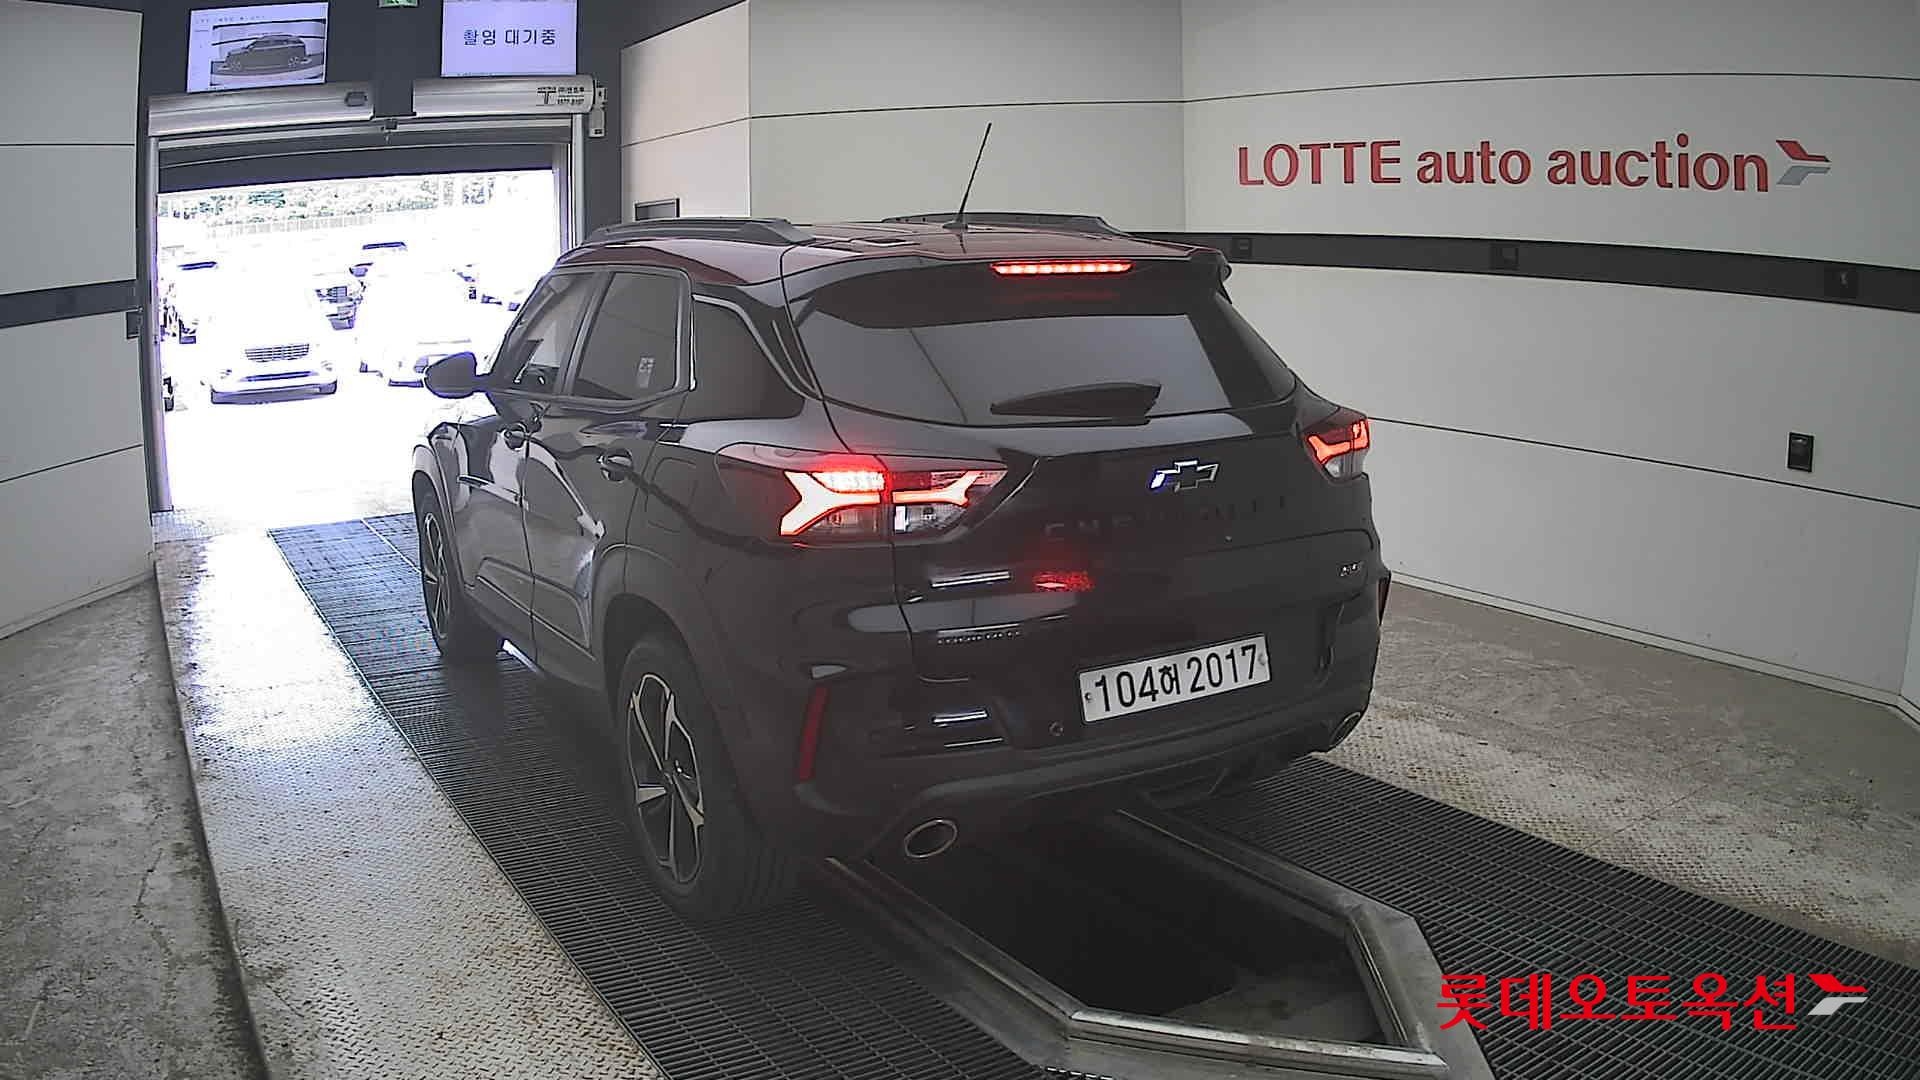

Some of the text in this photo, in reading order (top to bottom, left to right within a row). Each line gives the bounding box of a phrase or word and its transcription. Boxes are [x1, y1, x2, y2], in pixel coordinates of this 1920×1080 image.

[463, 29, 556, 46] 촬영 대기중
[1238, 133, 1769, 192] LOTTE auto auction
